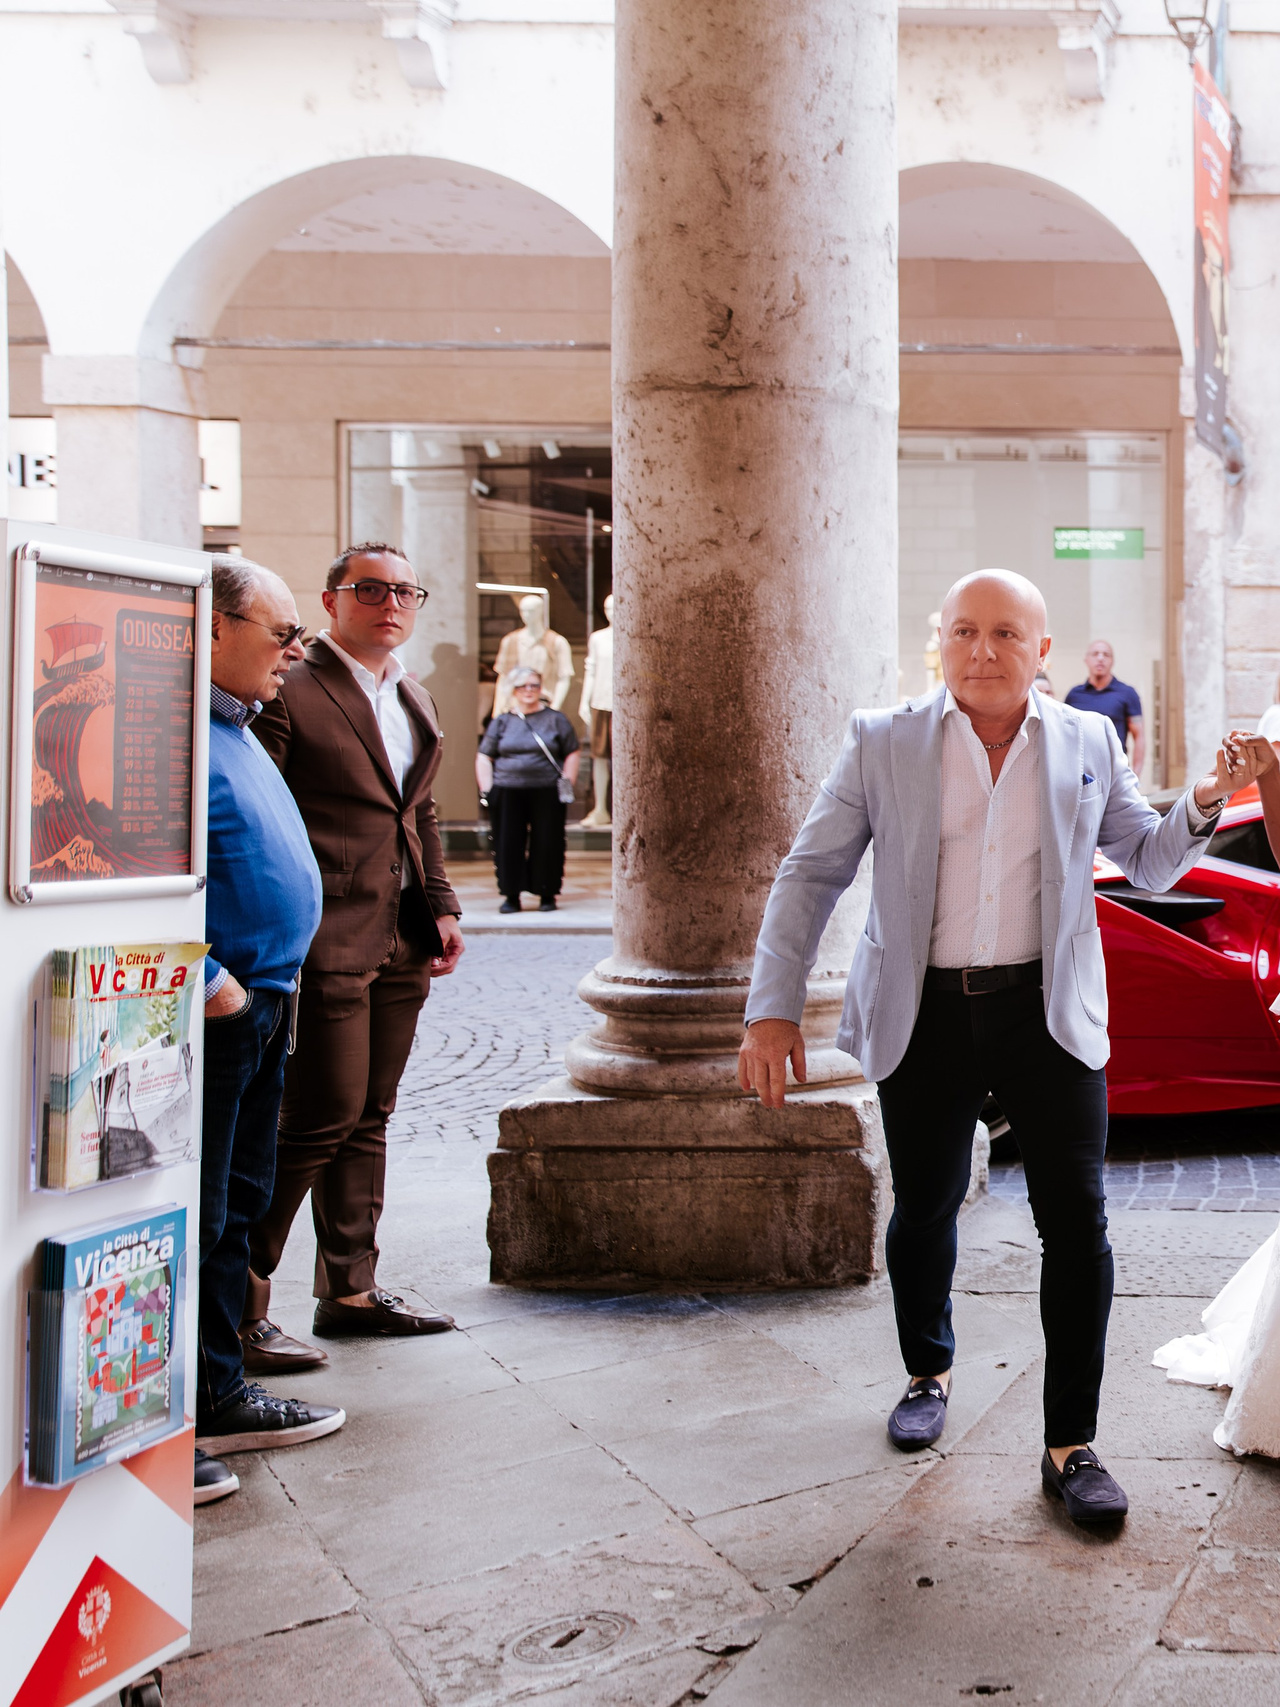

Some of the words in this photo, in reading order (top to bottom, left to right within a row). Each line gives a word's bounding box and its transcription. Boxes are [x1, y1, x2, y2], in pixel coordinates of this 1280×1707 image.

[122, 618, 194, 653] ODISSEA
[115, 954, 124, 966] la
[126, 952, 151, 966] Città
[153, 952, 166, 964] di
[89, 963, 188, 995] Vicenza
[103, 1239, 113, 1254] la
[114, 1231, 139, 1250] Città
[140, 1226, 150, 1242] di
[74, 1235, 175, 1288] Vicenza
[79, 1656, 107, 1679] Vicenza
